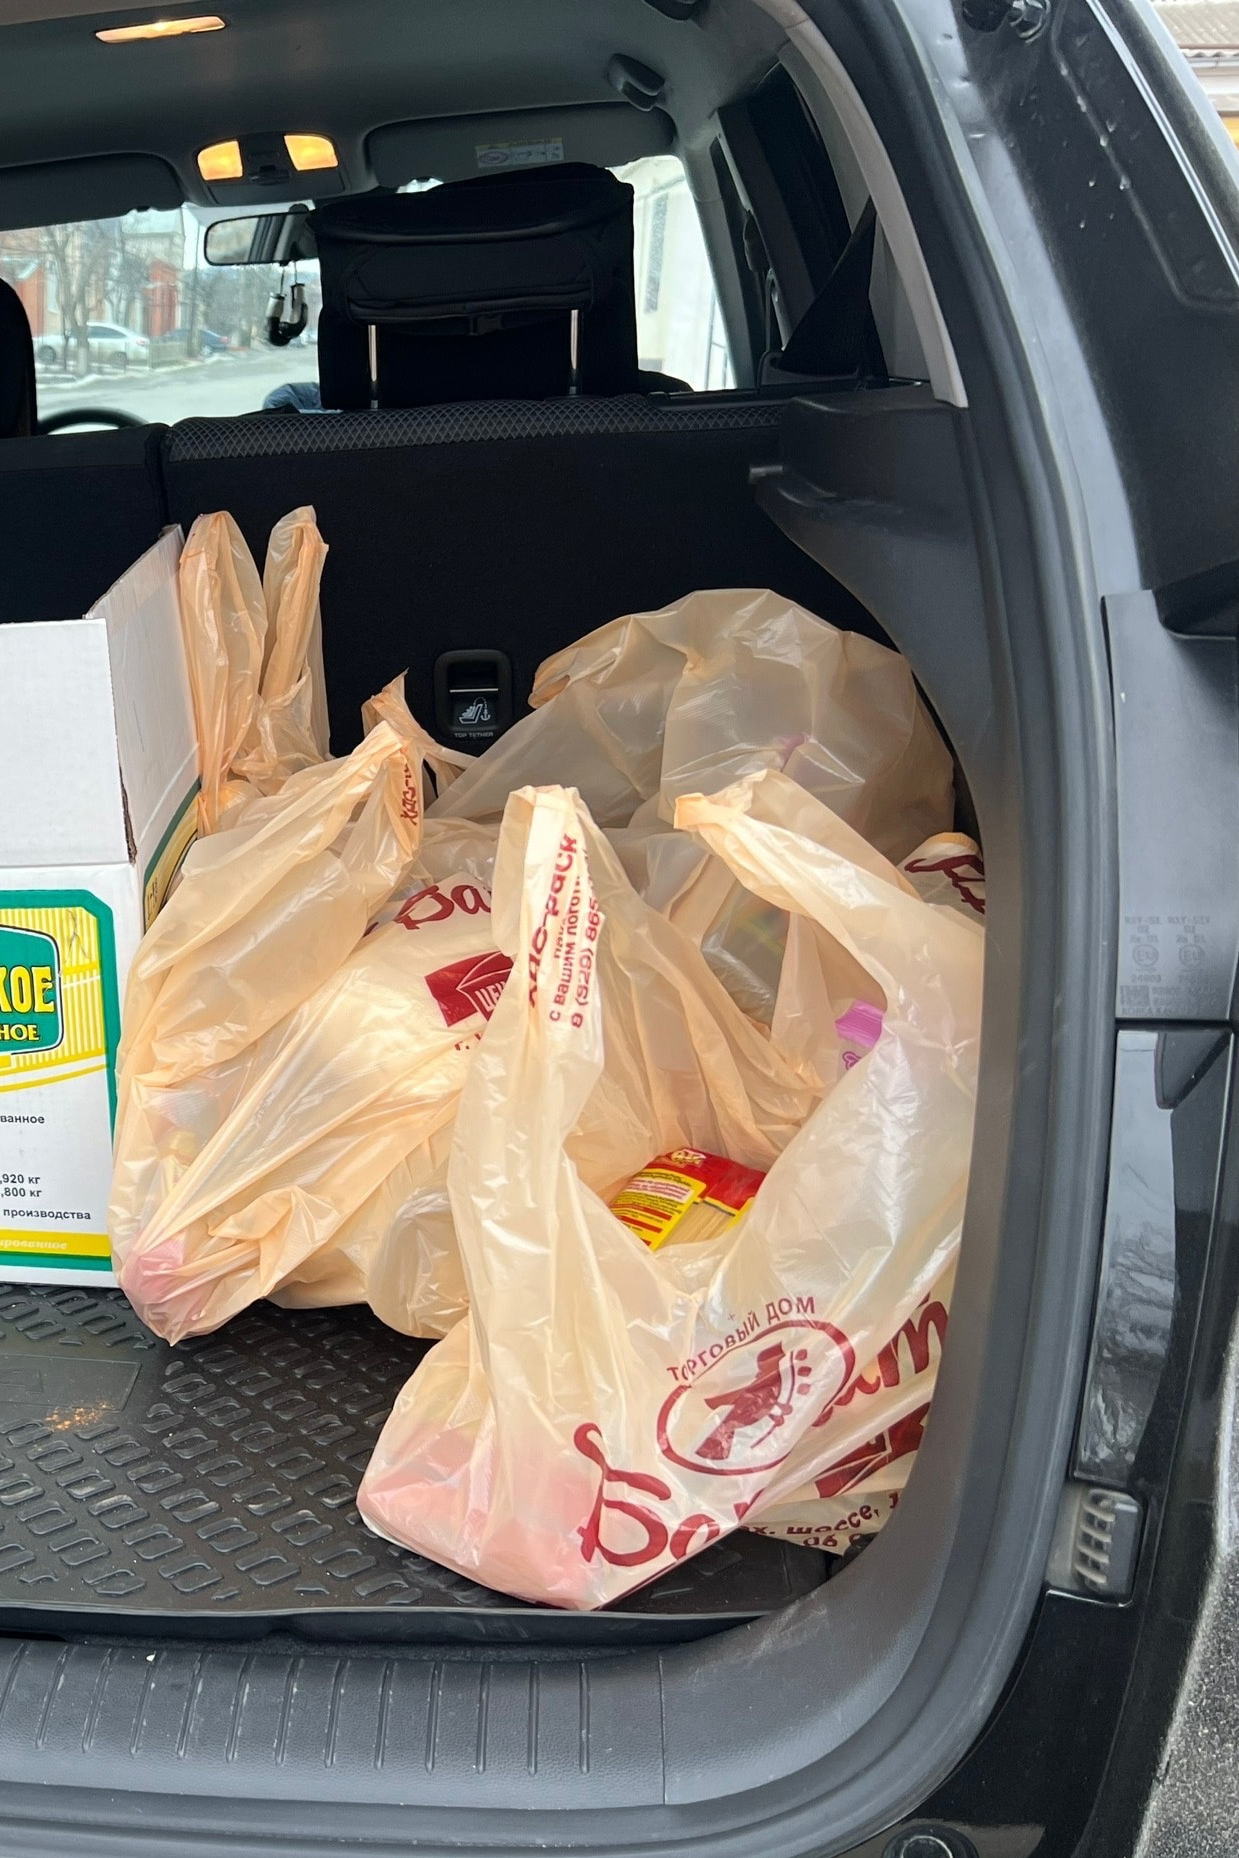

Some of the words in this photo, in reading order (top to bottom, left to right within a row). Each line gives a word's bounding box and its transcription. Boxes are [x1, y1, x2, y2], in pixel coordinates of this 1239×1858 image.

[28, 1175, 41, 1185] кг
[29, 1188, 42, 1198] кг
[3, 1208, 92, 1221] производства
[666, 1311, 760, 1381] ТОРГОВЫЙ
[765, 1296, 815, 1325] ДОМ
